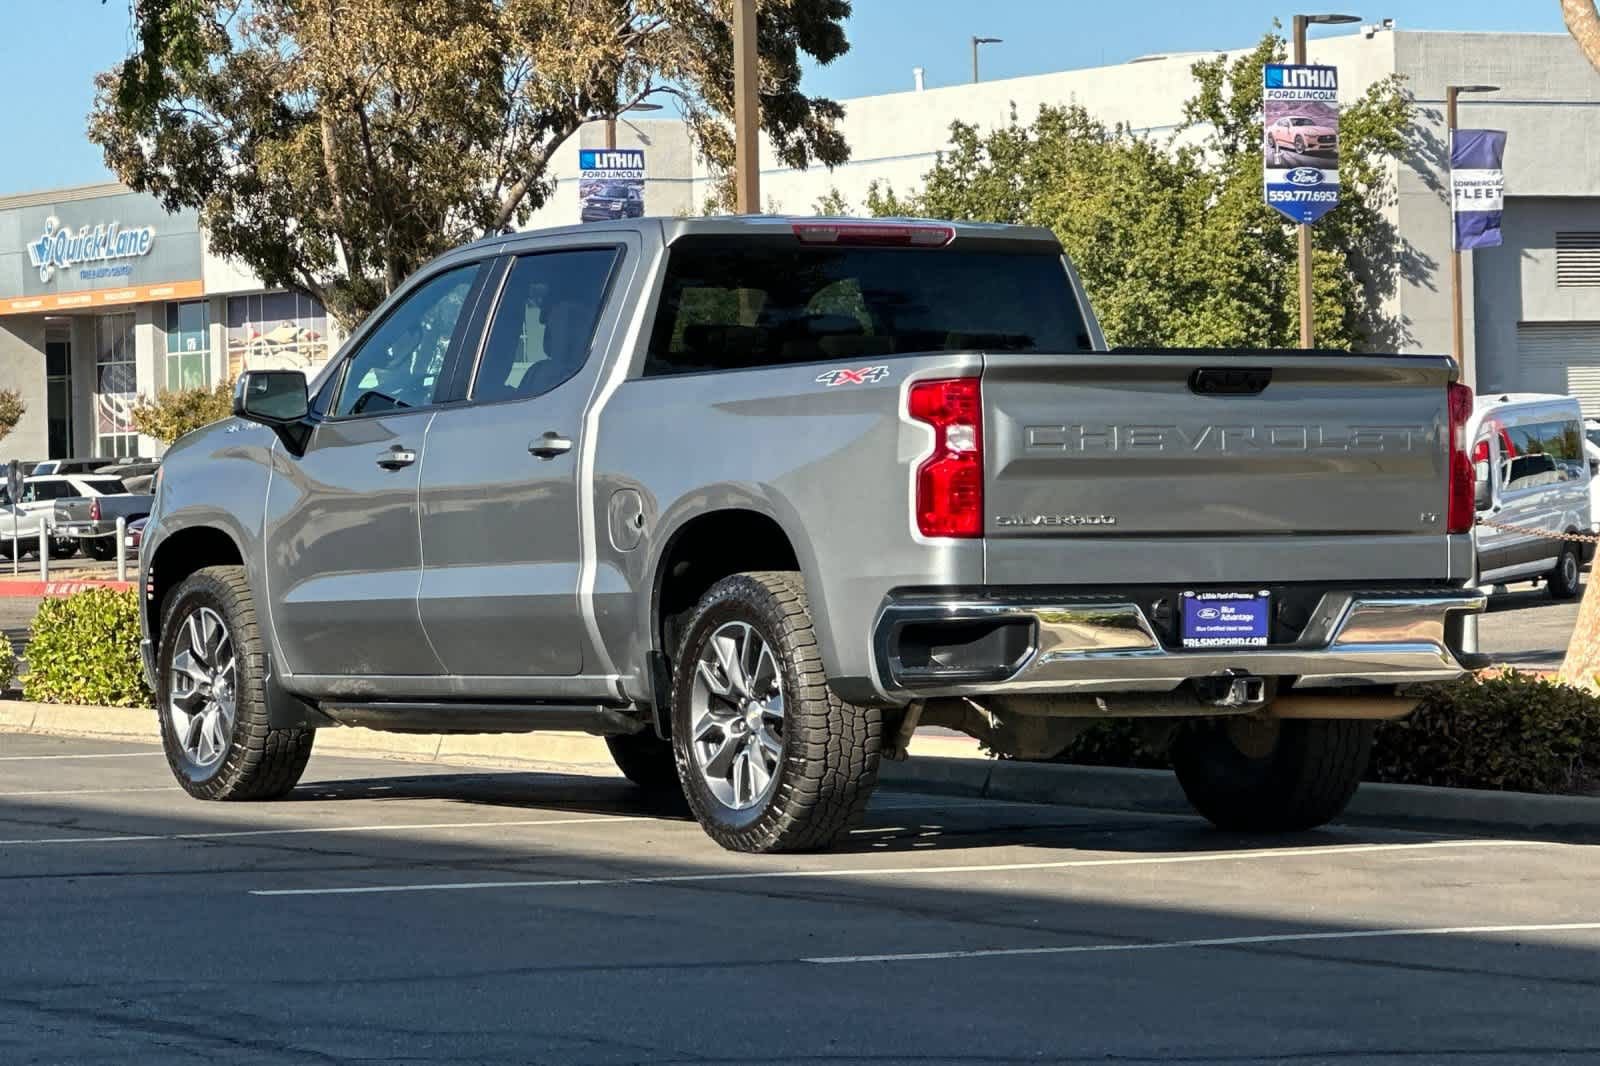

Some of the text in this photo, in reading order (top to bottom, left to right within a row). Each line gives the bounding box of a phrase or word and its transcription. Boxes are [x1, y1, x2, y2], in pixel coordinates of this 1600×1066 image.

[1282, 68, 1337, 88] LITHIA
[1267, 90, 1337, 100] FORD LINCOLN
[595, 152, 643, 168] LITHIA
[1292, 168, 1319, 183] Ford
[1454, 188, 1504, 198] FLEET
[54, 223, 153, 267] Quick Lane
[1024, 425, 1424, 451] CHEVROLET
[995, 514, 1117, 526] SILVERADO
